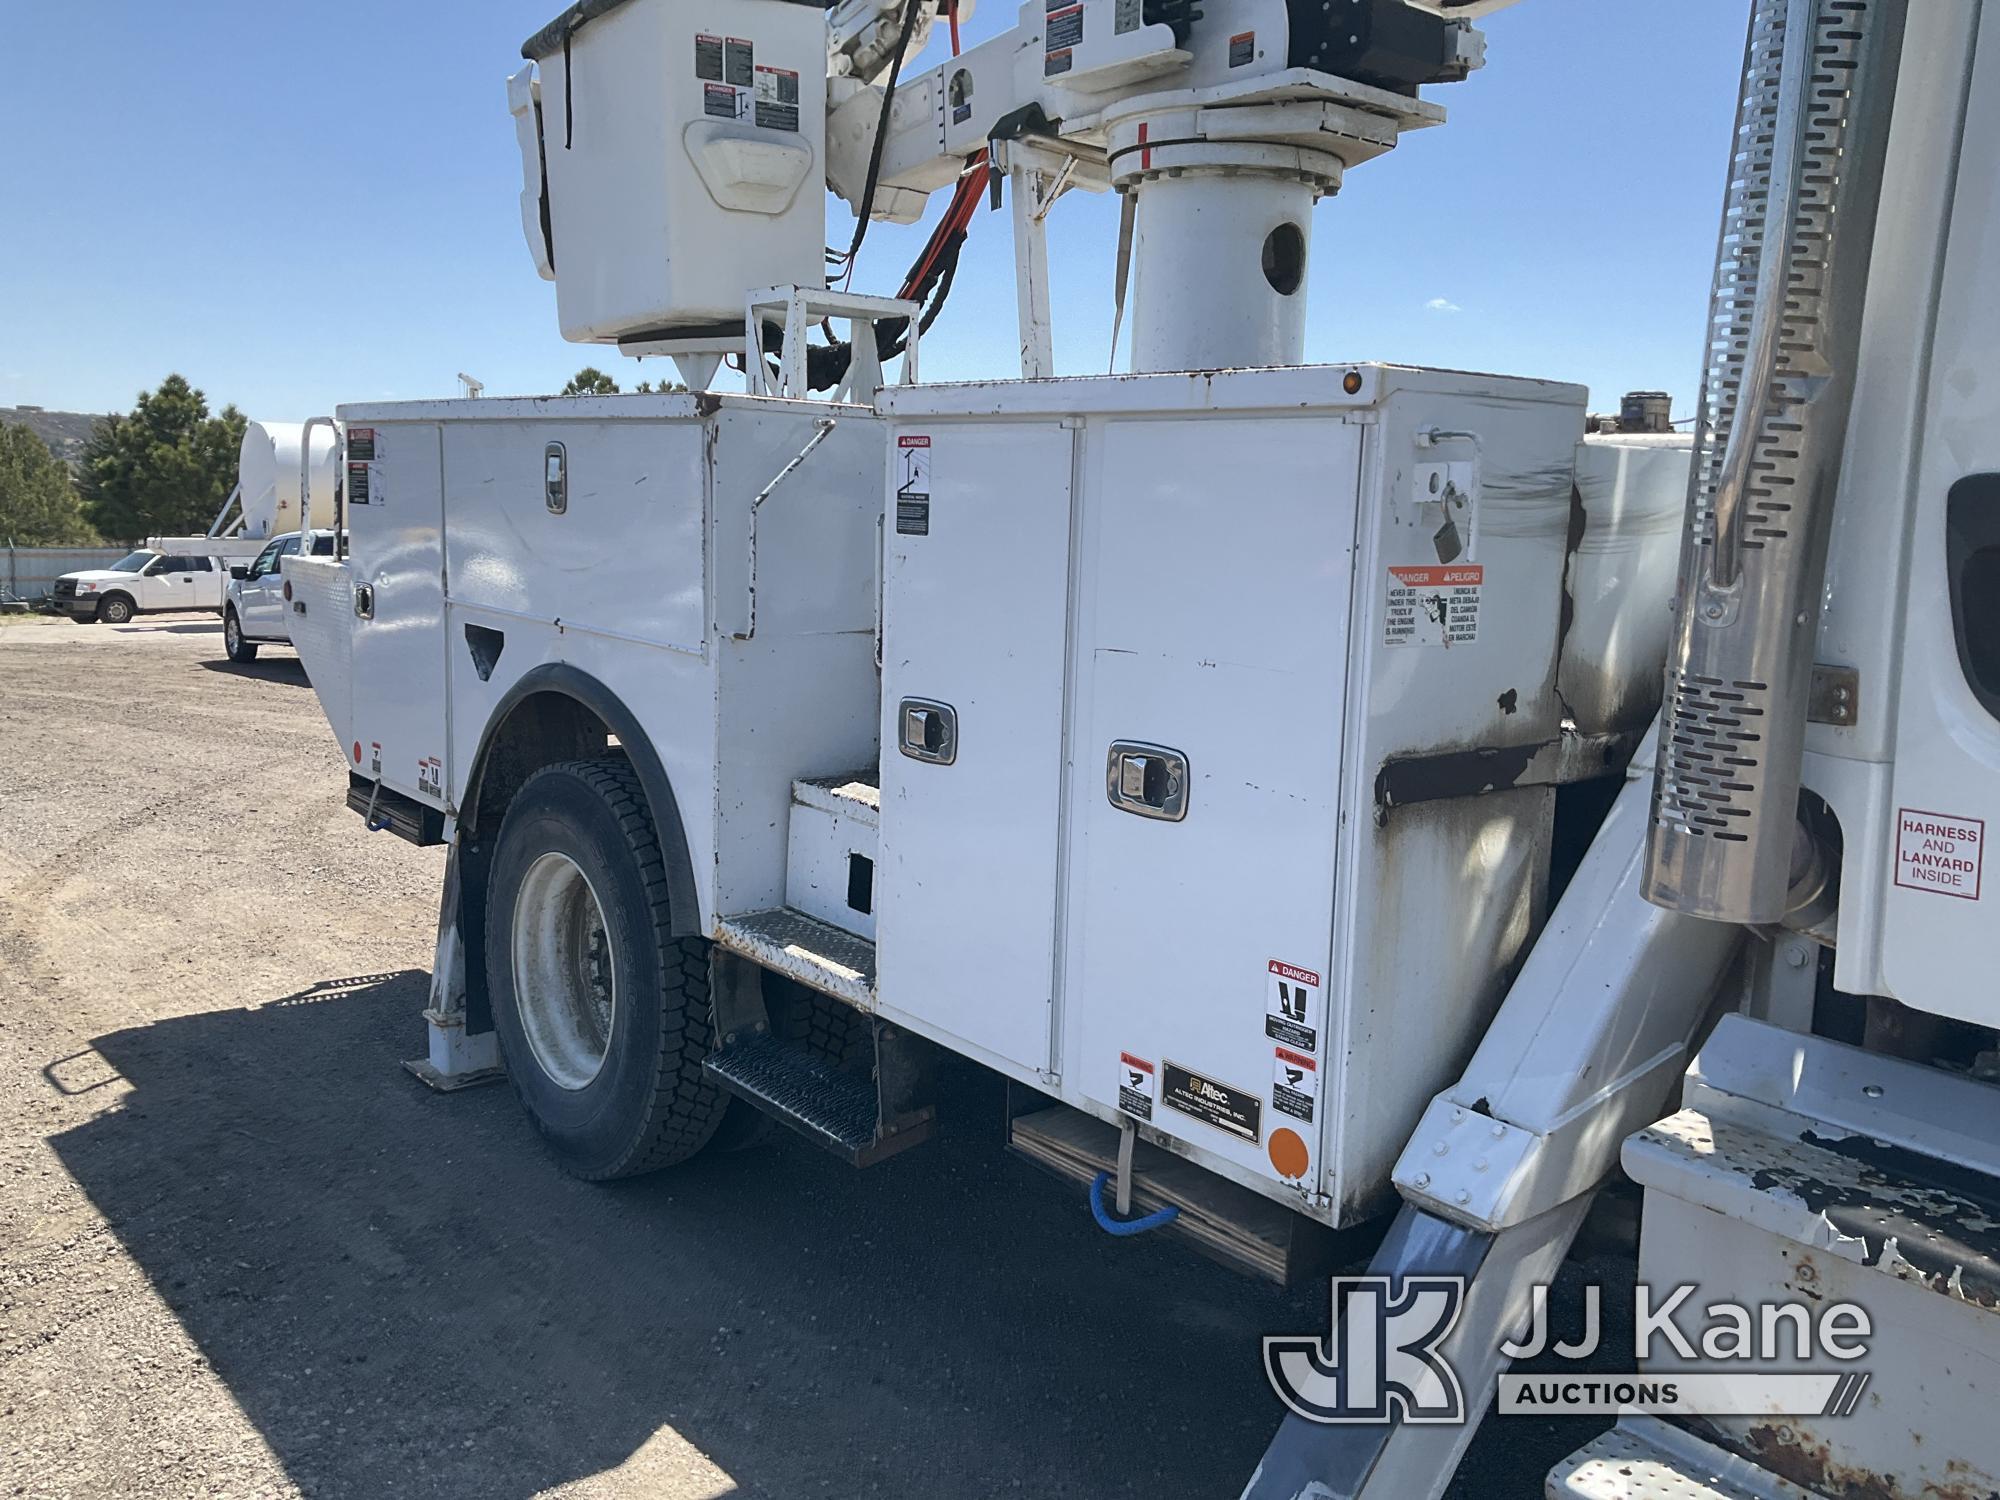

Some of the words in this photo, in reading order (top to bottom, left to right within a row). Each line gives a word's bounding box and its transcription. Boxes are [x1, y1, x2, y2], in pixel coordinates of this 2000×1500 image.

[906, 437, 929, 445] DANGER
[1450, 571, 1480, 582] PELIGRO
[1903, 820, 1977, 843] HARNESS
[1922, 838, 1955, 854] AND
[1902, 850, 1975, 873] LANYARD
[1912, 867, 1962, 886] INSIDE
[1282, 966, 1317, 985] DANGER
[1268, 1015, 1287, 1026] MOVING
[1286, 1021, 1313, 1034] OUTRIGGER
[1282, 1026, 1301, 1036] HAZARD
[1275, 1033, 1290, 1042] STAND
[1289, 1039, 1305, 1047] CLEAR
[1201, 1082, 1228, 1104] Altec
[1174, 1087, 1194, 1100] ALTEC
[1194, 1095, 1233, 1117] INDUSTRIES,
[1233, 1111, 1247, 1122] INC.
